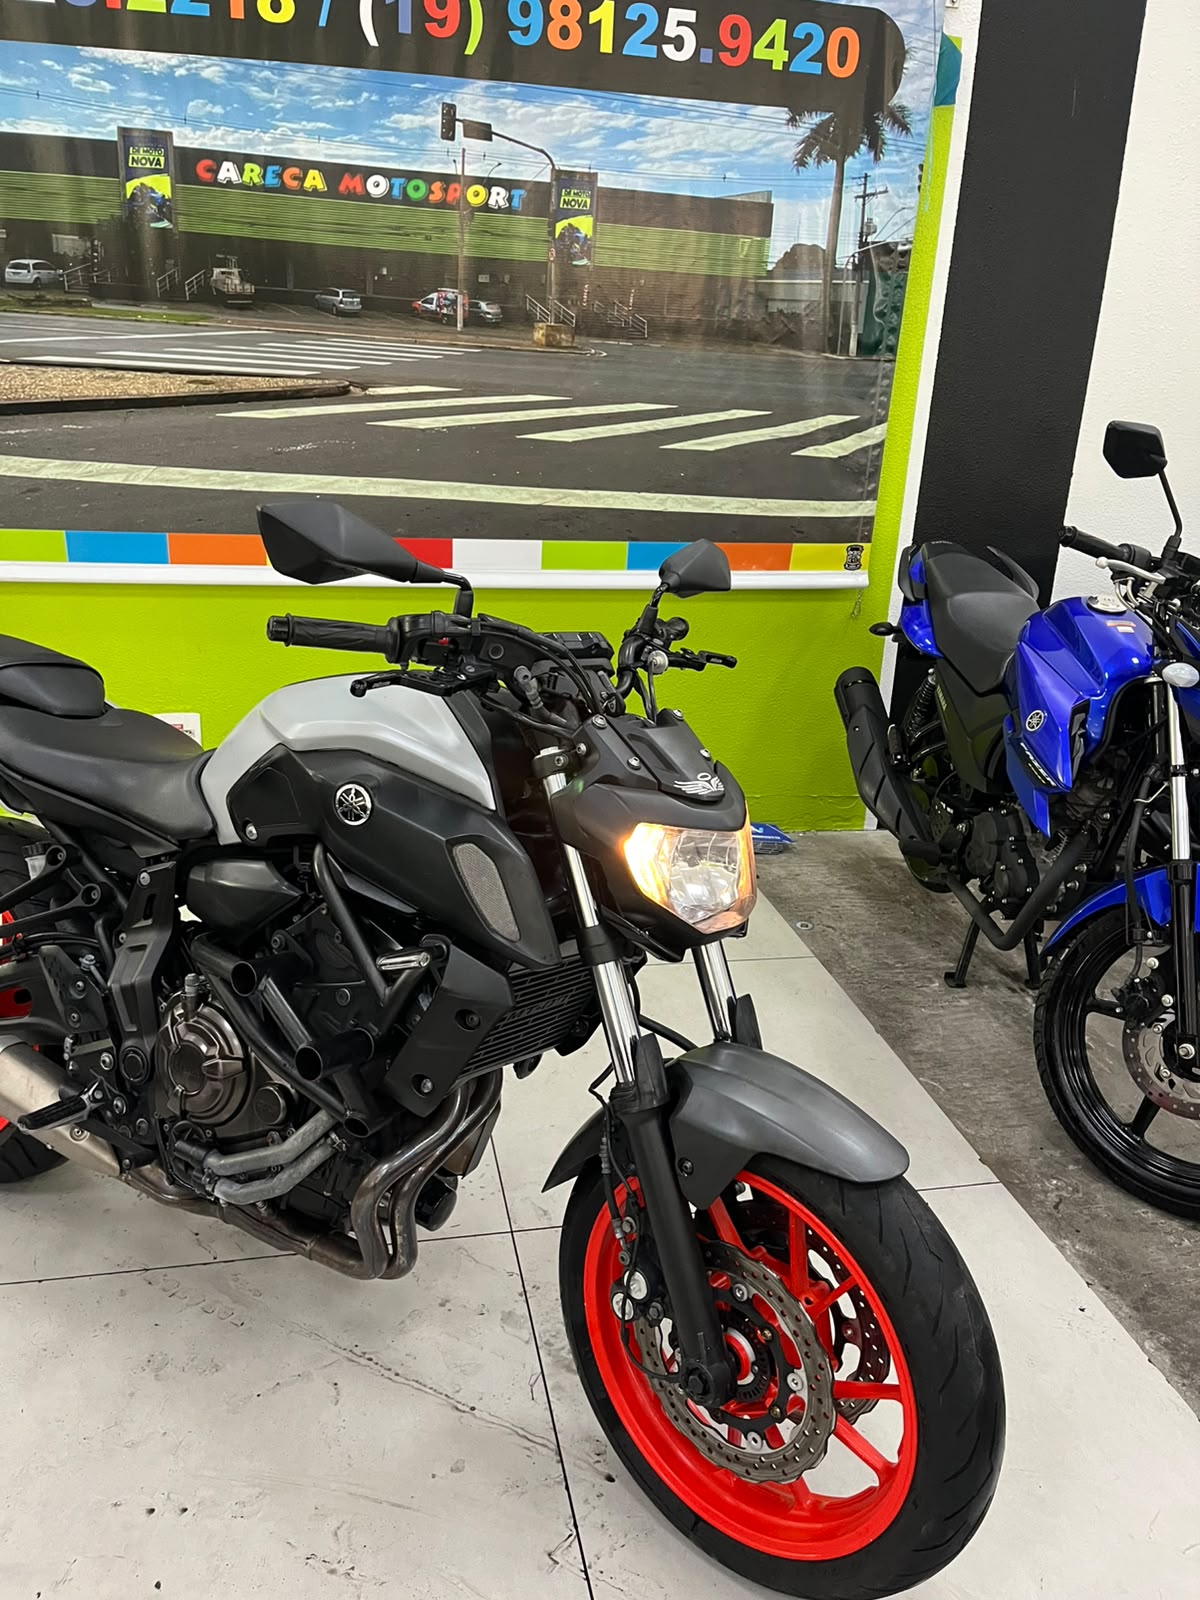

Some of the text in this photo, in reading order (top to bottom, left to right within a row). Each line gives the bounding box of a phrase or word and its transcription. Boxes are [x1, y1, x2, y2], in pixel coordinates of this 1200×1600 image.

[359, 0, 484, 55] (19)
[507, 0, 861, 79] 98125.9420
[131, 156, 162, 167] NOVA
[195, 158, 528, 211] CARECA MOTOSPORT
[562, 198, 588, 208] NOVA
